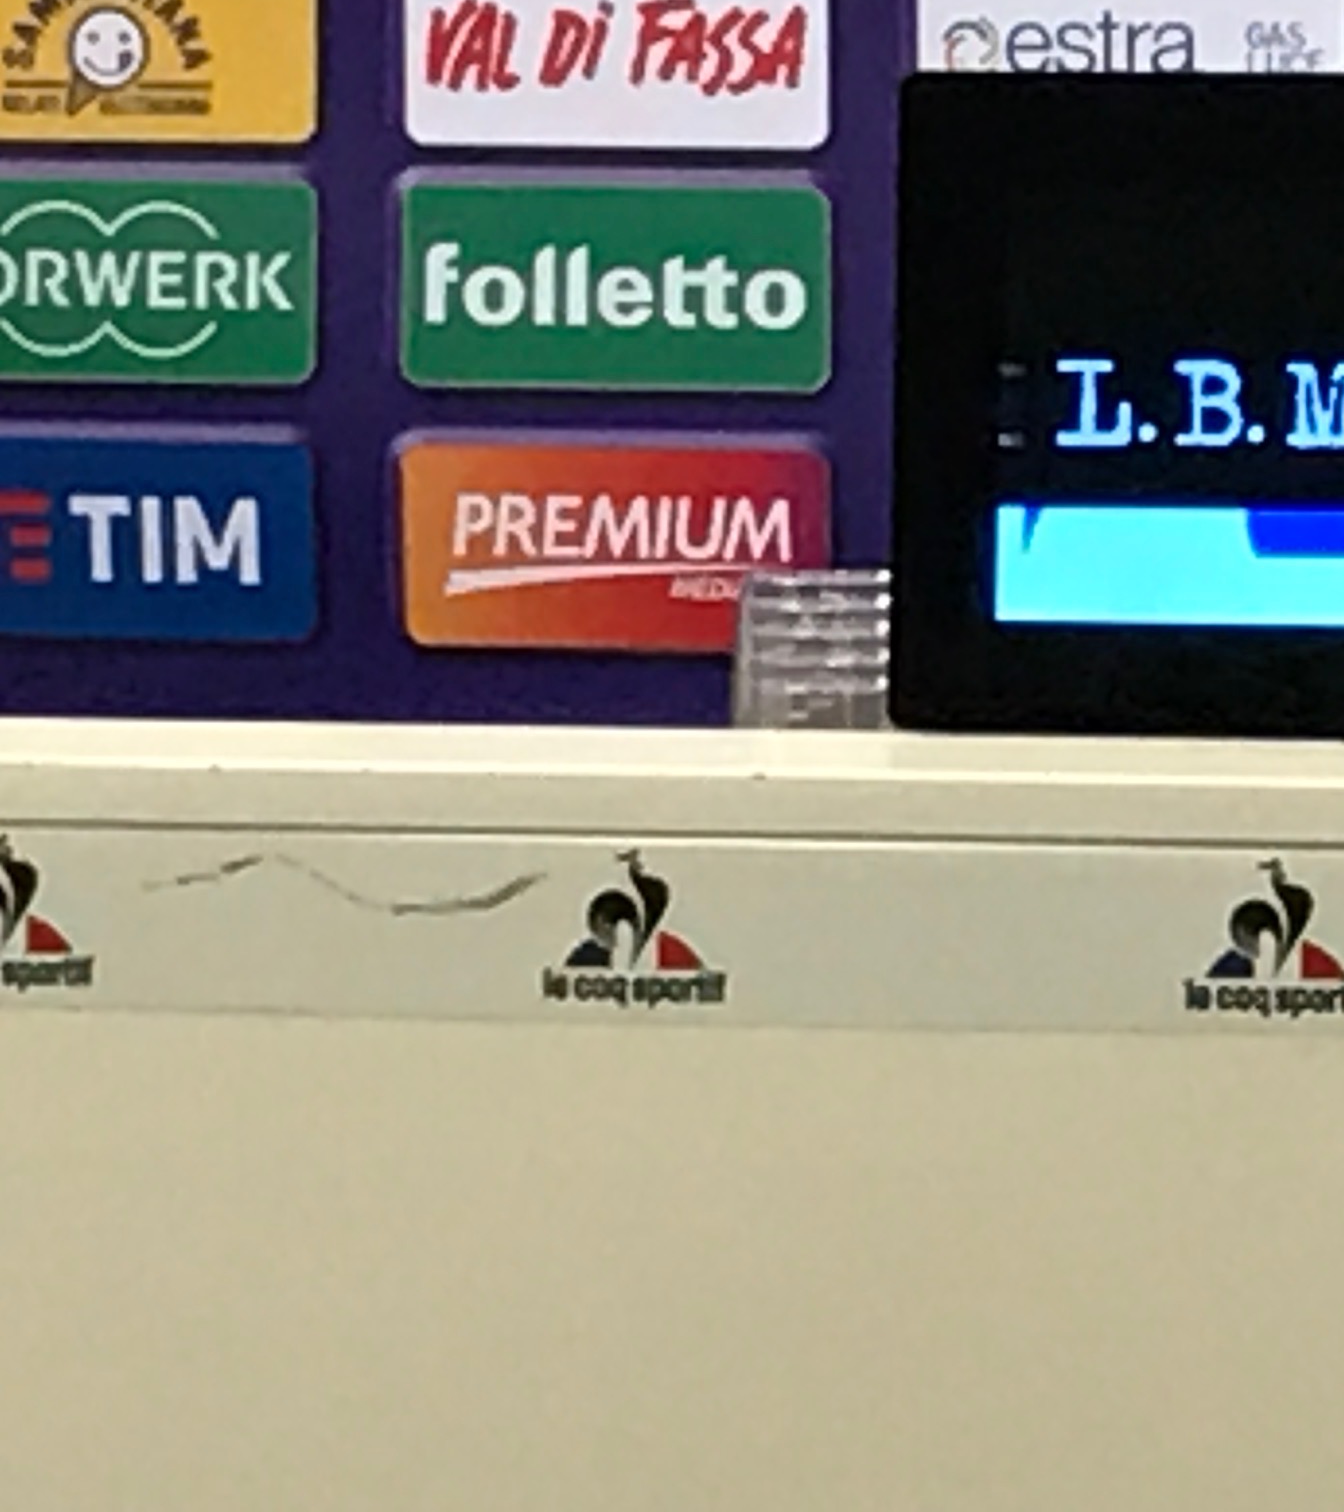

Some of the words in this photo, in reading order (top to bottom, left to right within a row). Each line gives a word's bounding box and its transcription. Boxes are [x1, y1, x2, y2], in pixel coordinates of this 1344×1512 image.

[1005, 9, 1197, 72] estra
[423, 242, 807, 330] folletto
[69, 495, 262, 585] TIM
[451, 492, 793, 563] PREMIUM
[574, 974, 628, 1007] coq
[1216, 986, 1271, 1017] coq
